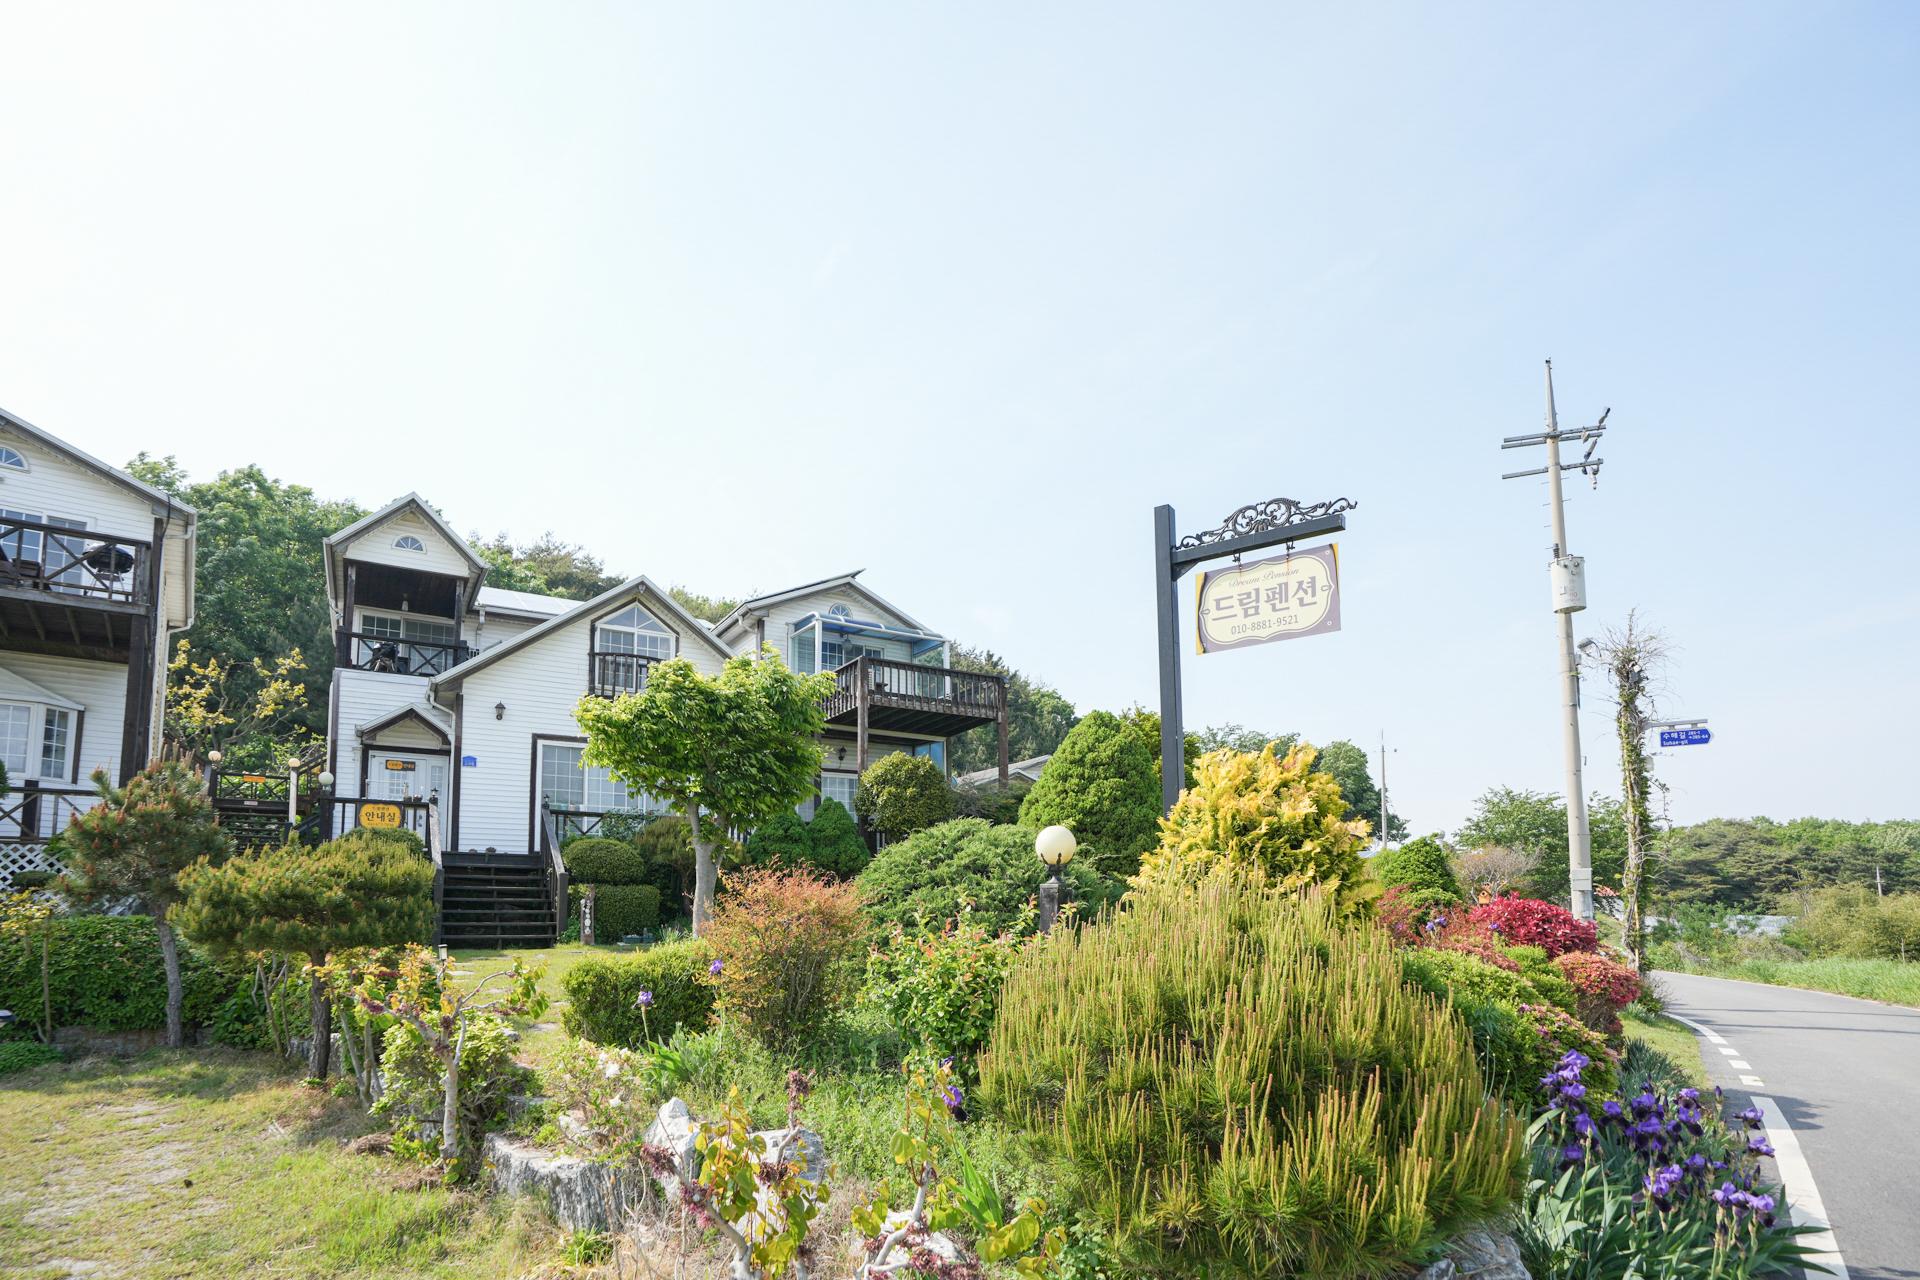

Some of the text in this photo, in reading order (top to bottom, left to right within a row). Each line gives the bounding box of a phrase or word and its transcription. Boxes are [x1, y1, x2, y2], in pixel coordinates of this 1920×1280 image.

[1212, 575, 1318, 621] 드림펜션
[1231, 614, 1299, 635] 010-8881-9521
[365, 811, 396, 823] 안내실
